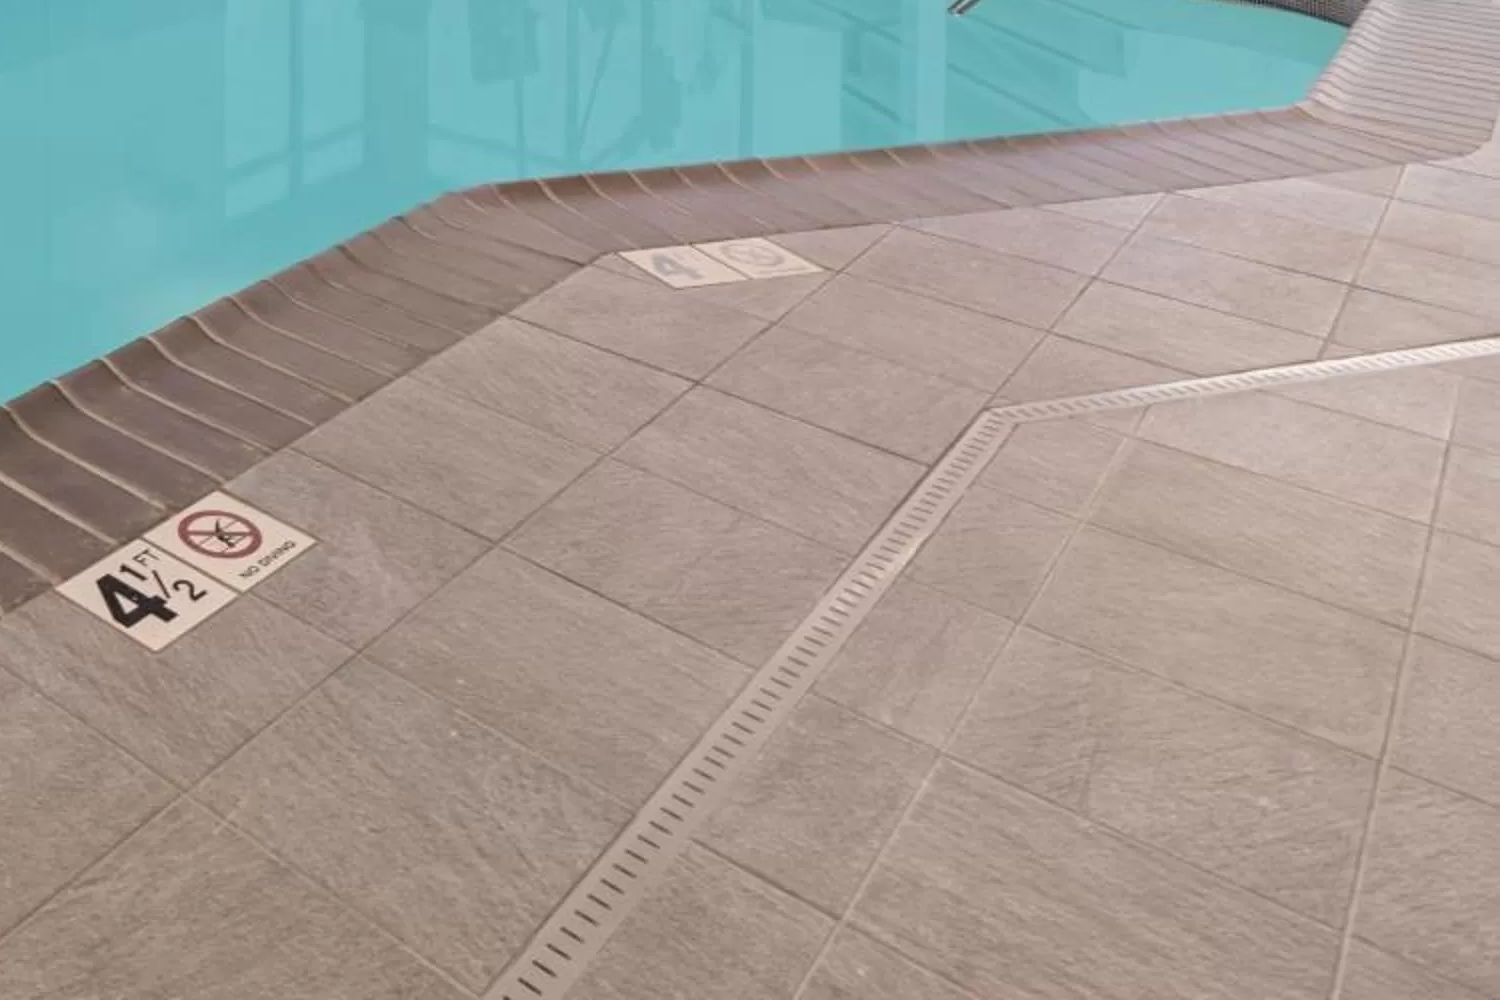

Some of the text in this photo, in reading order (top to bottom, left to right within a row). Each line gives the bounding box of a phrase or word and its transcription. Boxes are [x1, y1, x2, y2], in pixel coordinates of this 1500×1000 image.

[652, 254, 704, 281] 4
[132, 548, 160, 567] FT
[238, 564, 261, 578] NO
